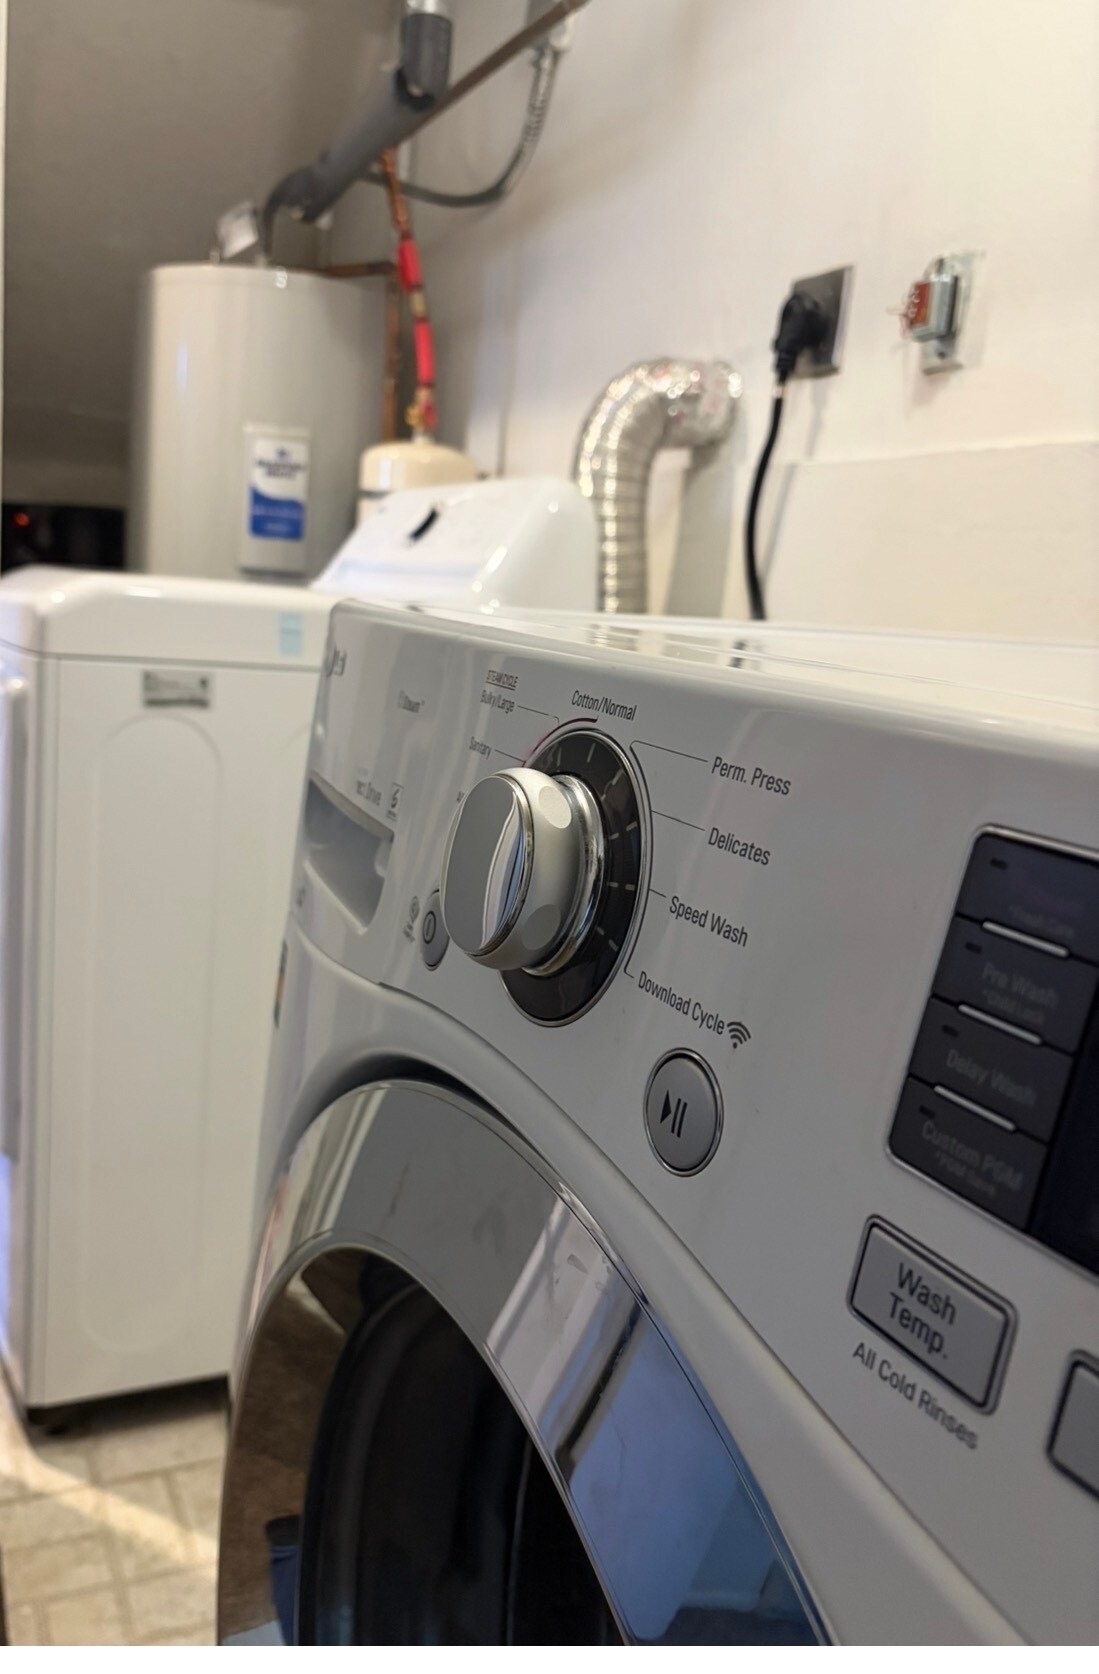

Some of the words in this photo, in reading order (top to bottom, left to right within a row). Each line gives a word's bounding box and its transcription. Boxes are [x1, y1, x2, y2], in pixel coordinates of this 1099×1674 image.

[480, 689, 515, 714] Bulky/Large
[571, 690, 637, 722] Cotton/Normal
[468, 736, 493, 760] Sanitary
[711, 756, 747, 784] Perm.
[750, 767, 792, 796] Press
[708, 827, 771, 866] Delicates
[669, 895, 709, 929] Speed
[710, 913, 749, 947] Wash
[638, 970, 692, 1016] Download
[691, 1002, 726, 1036] Cycle
[946, 1048, 988, 1085] Delay
[990, 1068, 1038, 1107] Wash
[922, 1119, 981, 1168] Custom
[898, 1262, 957, 1326] Wash
[889, 1291, 948, 1360] Temp.
[852, 1342, 878, 1371] All
[877, 1359, 917, 1402] Cold
[916, 1389, 980, 1452] Rinses
